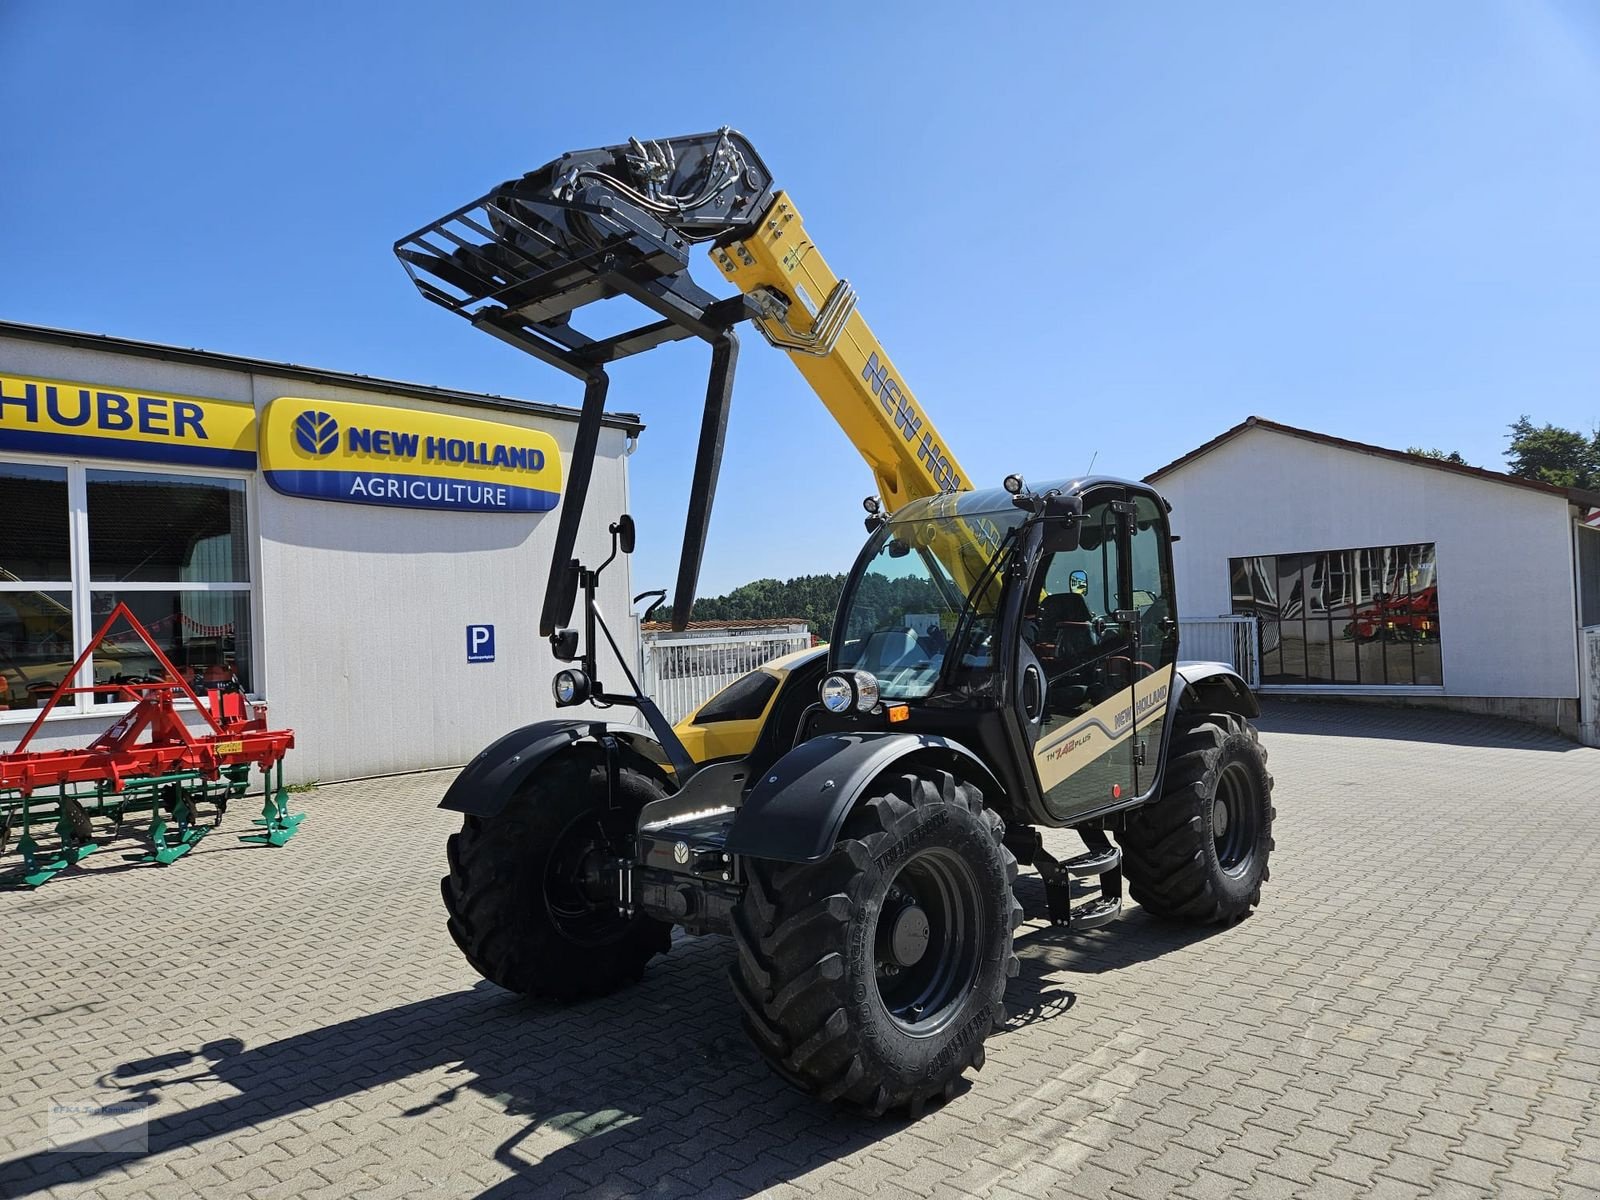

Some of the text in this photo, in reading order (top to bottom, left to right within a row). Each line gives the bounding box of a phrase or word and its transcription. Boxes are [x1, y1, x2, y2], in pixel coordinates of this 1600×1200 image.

[0, 381, 208, 440] HUBER
[861, 351, 922, 442] NEW
[349, 427, 545, 471] NEW HOLLAND
[350, 476, 507, 506] AGRICULTURE
[472, 627, 490, 654] P
[1114, 684, 1168, 730] NEW HOLLAND
[1046, 752, 1055, 762] TH
[1074, 733, 1092, 748] PLUS
